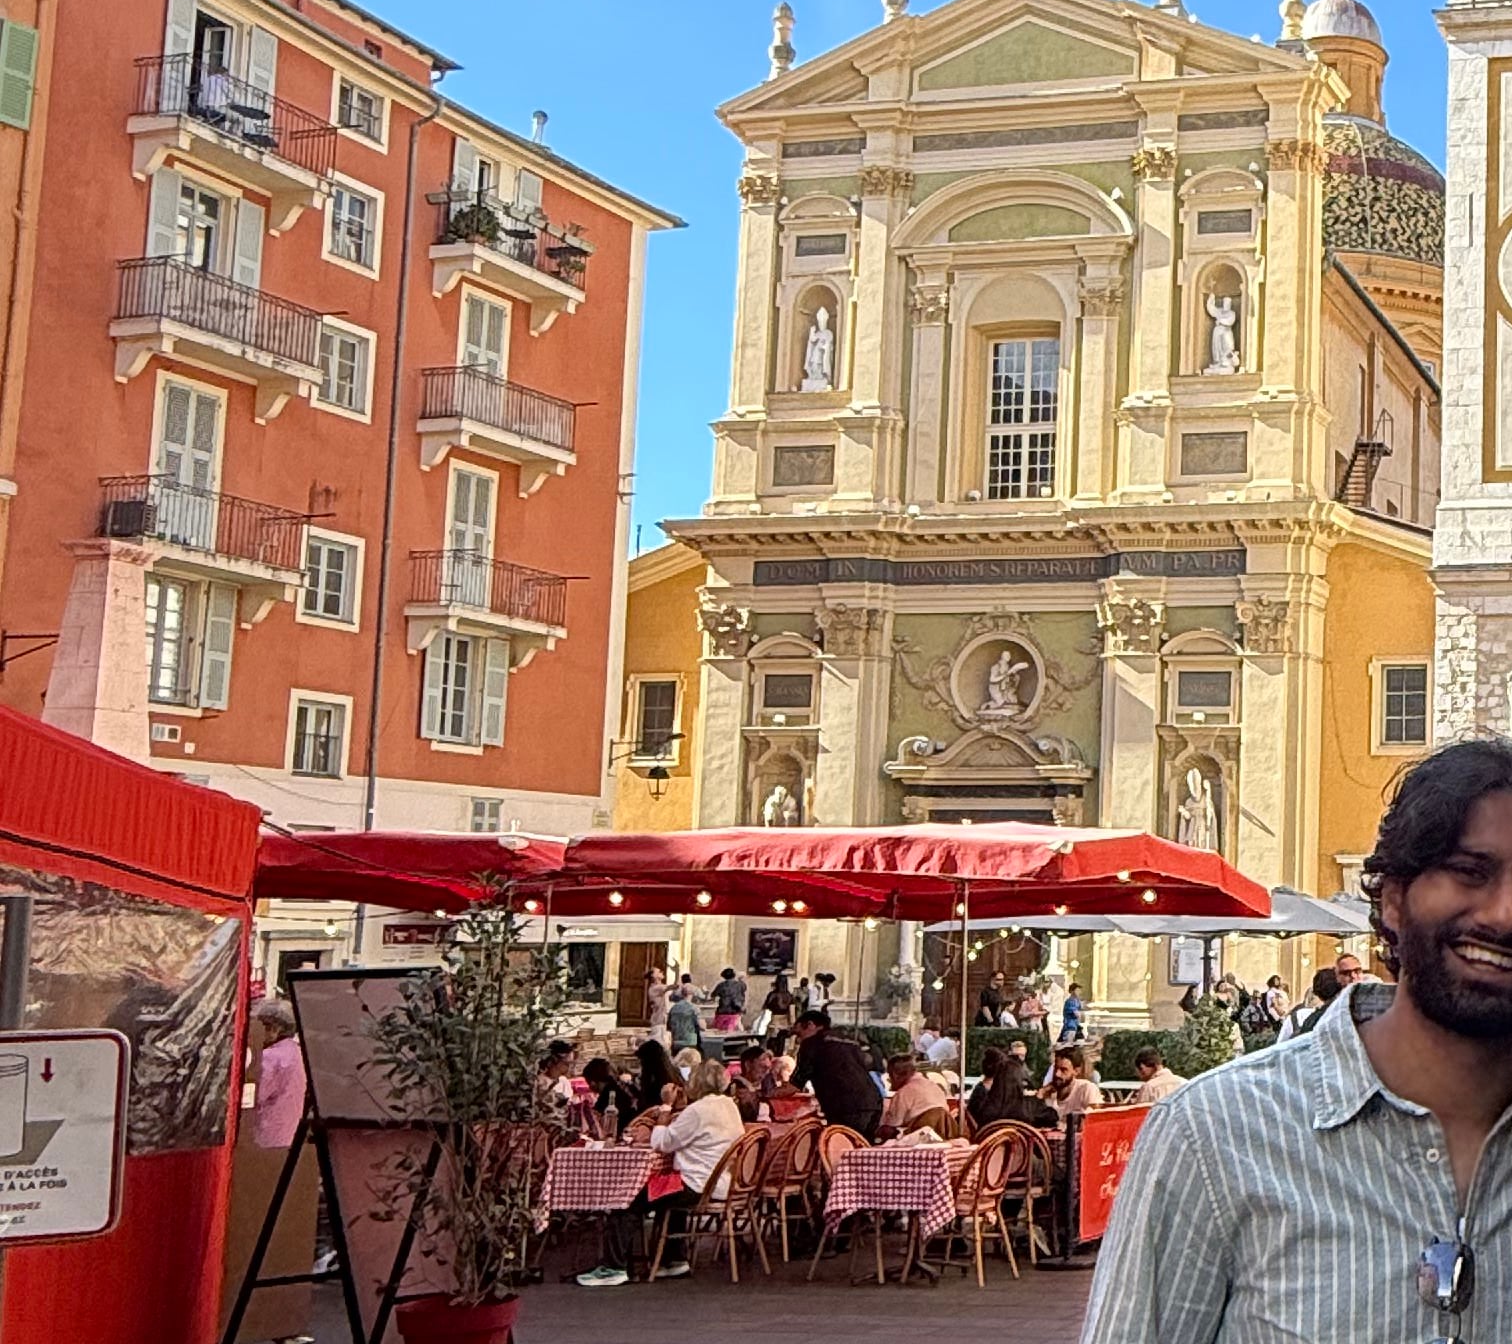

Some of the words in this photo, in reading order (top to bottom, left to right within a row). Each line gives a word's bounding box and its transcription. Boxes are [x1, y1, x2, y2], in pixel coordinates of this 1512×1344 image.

[836, 562, 857, 578] IN
[903, 563, 984, 579] HONOREM
[19, 1181, 36, 1192] LA
[39, 1179, 67, 1189] FOIS
